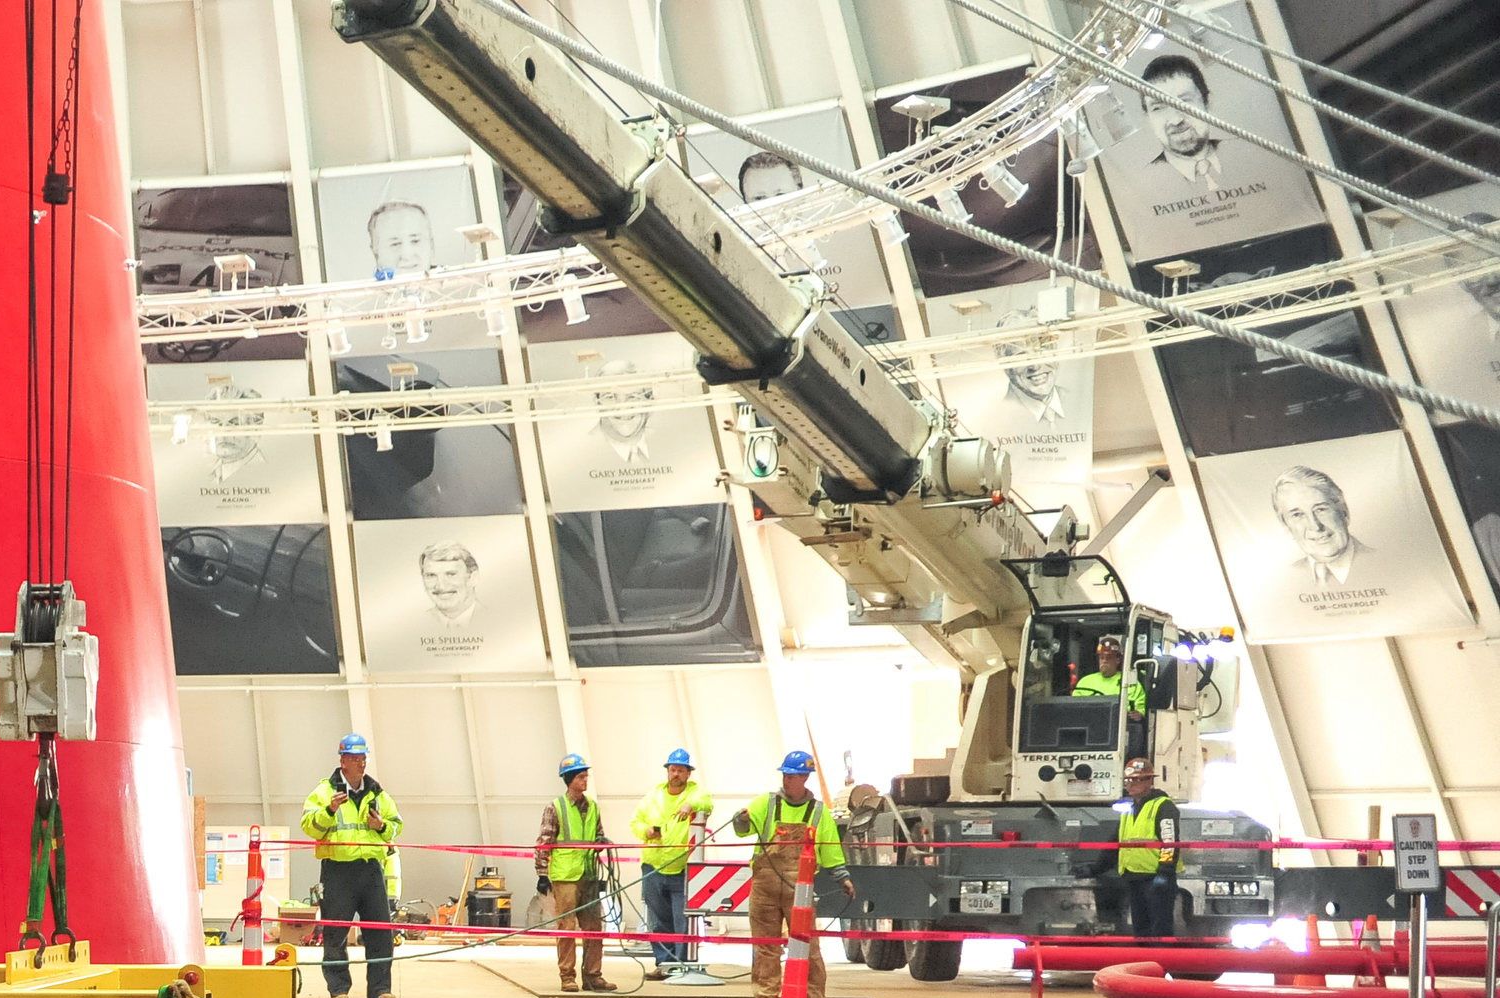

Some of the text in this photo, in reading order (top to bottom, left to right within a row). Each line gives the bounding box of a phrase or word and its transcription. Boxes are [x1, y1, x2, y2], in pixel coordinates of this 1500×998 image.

[1153, 182, 1267, 216] PATRICK DOLAN
[1189, 202, 1237, 219] ENTHUSIAST
[997, 436, 1023, 447] JOHN
[589, 466, 673, 479] GARY MORTIMER
[200, 487, 271, 496] DOUG HOOPER
[1299, 587, 1388, 603] GIB HUFSTADER
[420, 636, 484, 645] JOE SPIELMAN
[1093, 771, 1111, 779] 220
[1400, 841, 1434, 851] CAUTION
[1407, 855, 1427, 865] STEP
[1407, 869, 1430, 879] DOWN
